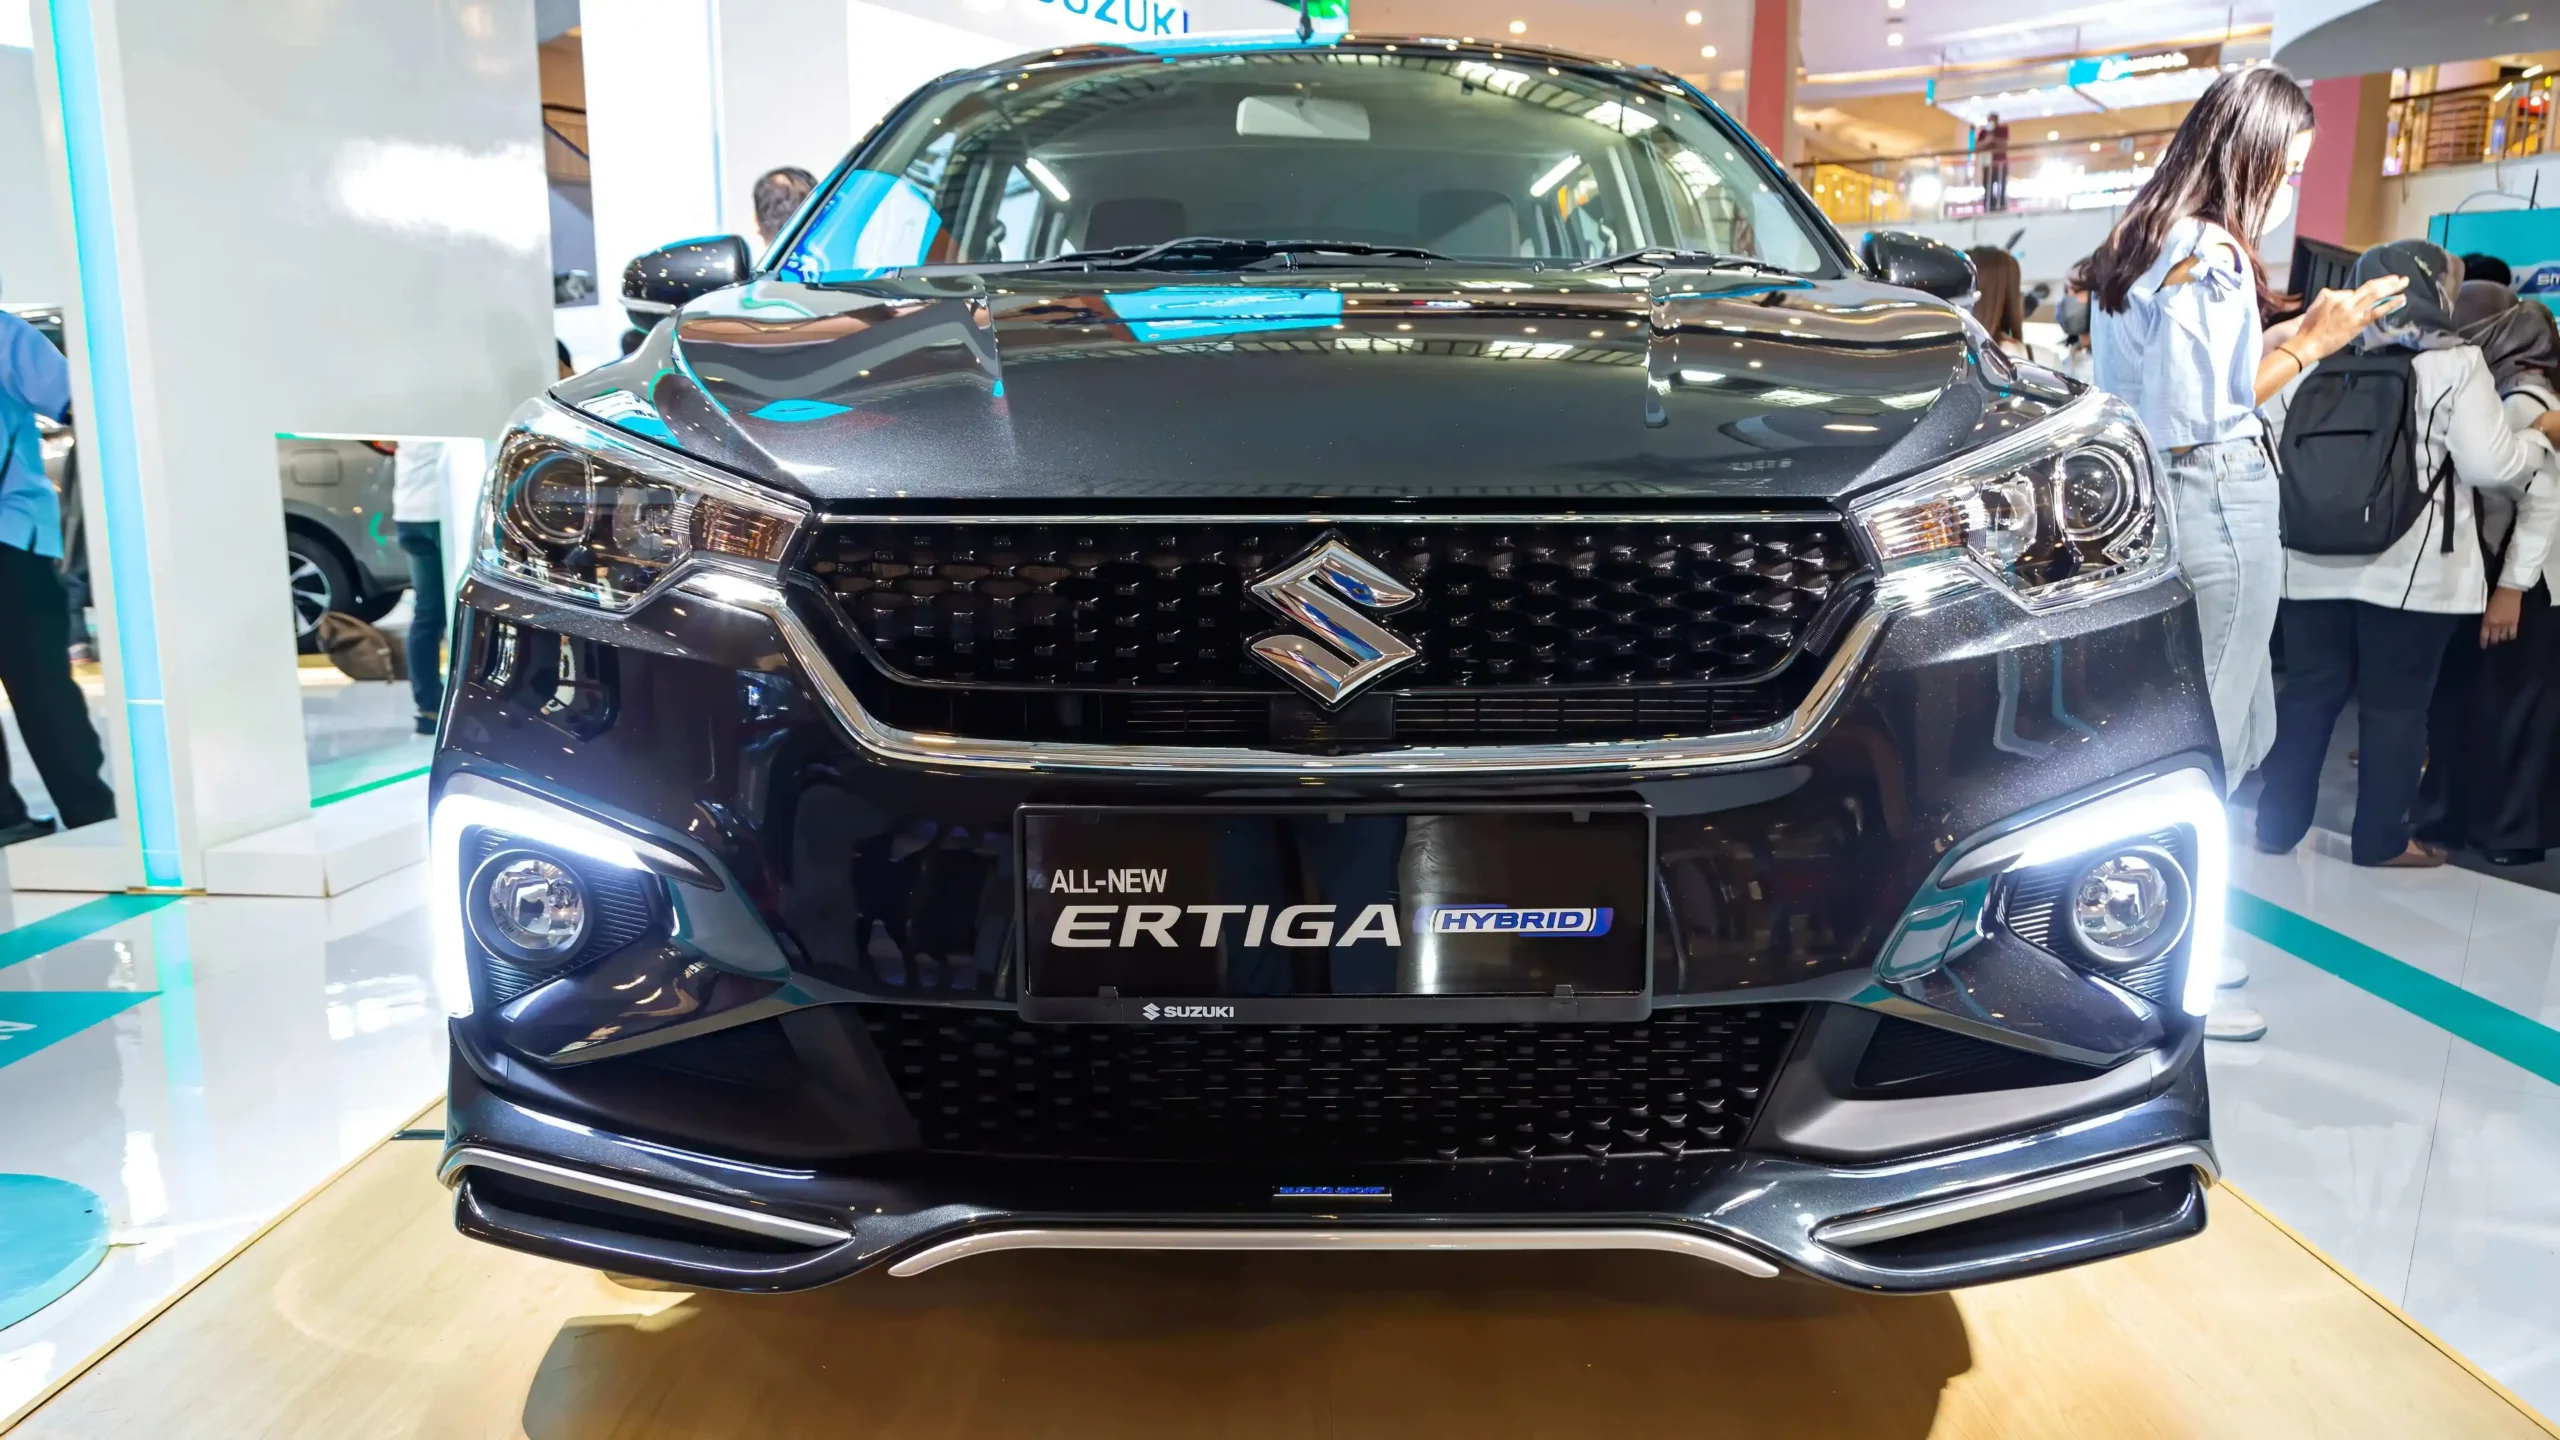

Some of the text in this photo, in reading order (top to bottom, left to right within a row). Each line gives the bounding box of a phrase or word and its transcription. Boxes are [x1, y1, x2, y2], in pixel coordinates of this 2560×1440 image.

[1050, 868, 1168, 894] ALL-NEW
[1051, 905, 1586, 947] ERTIGA HYBRID
[1163, 1005, 1235, 1018] SUZUKI
